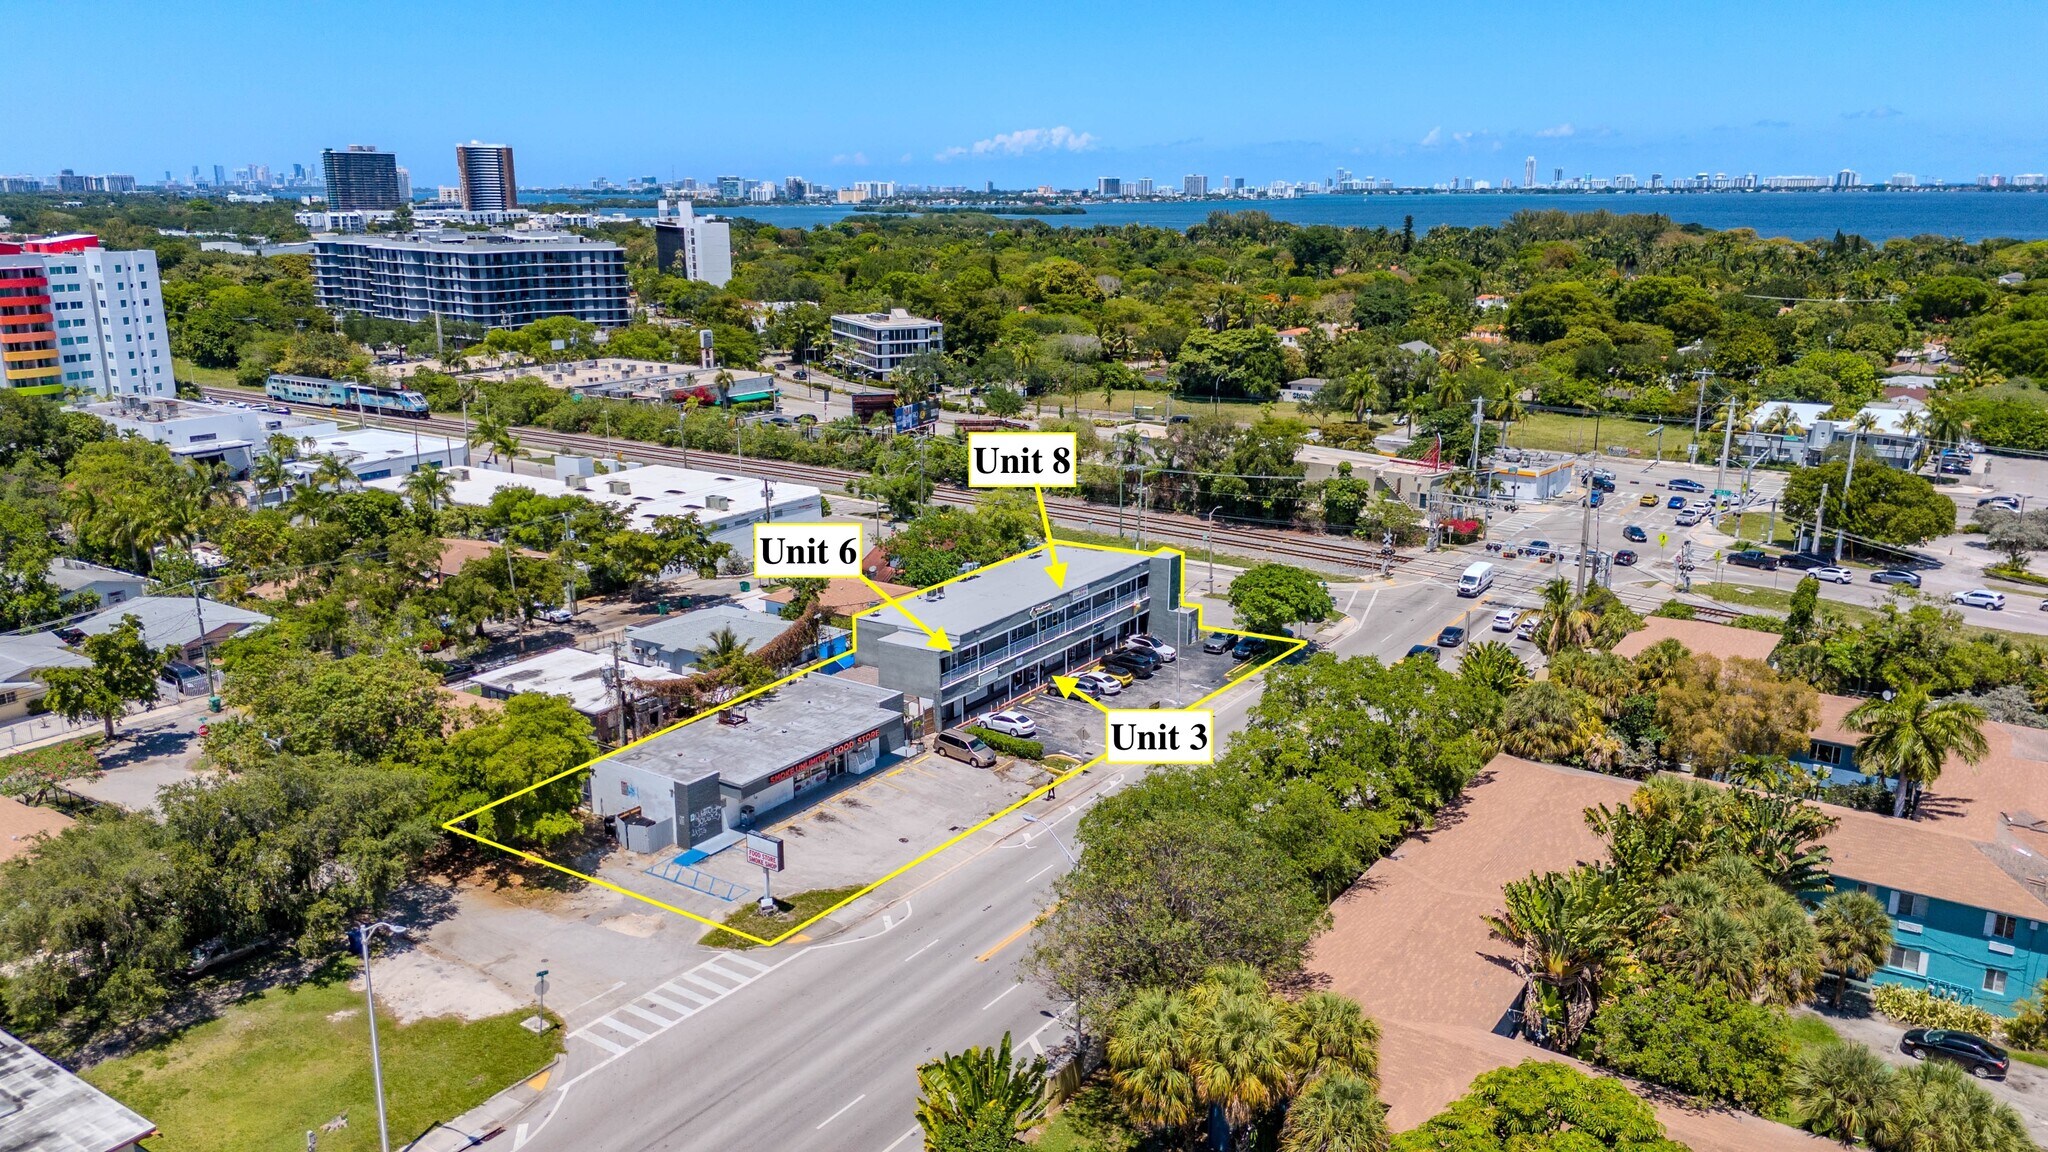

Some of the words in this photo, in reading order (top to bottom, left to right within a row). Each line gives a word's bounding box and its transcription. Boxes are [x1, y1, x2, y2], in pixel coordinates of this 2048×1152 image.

[833, 741, 854, 755] FOOD
[857, 729, 880, 745] STORE
[770, 767, 795, 783] SMOKE
[795, 752, 830, 771] UNLIMITED
[749, 850, 761, 858] FOOD
[762, 854, 776, 863] STORE
[749, 856, 764, 865] SMOKE
[765, 861, 777, 869] SHOP
